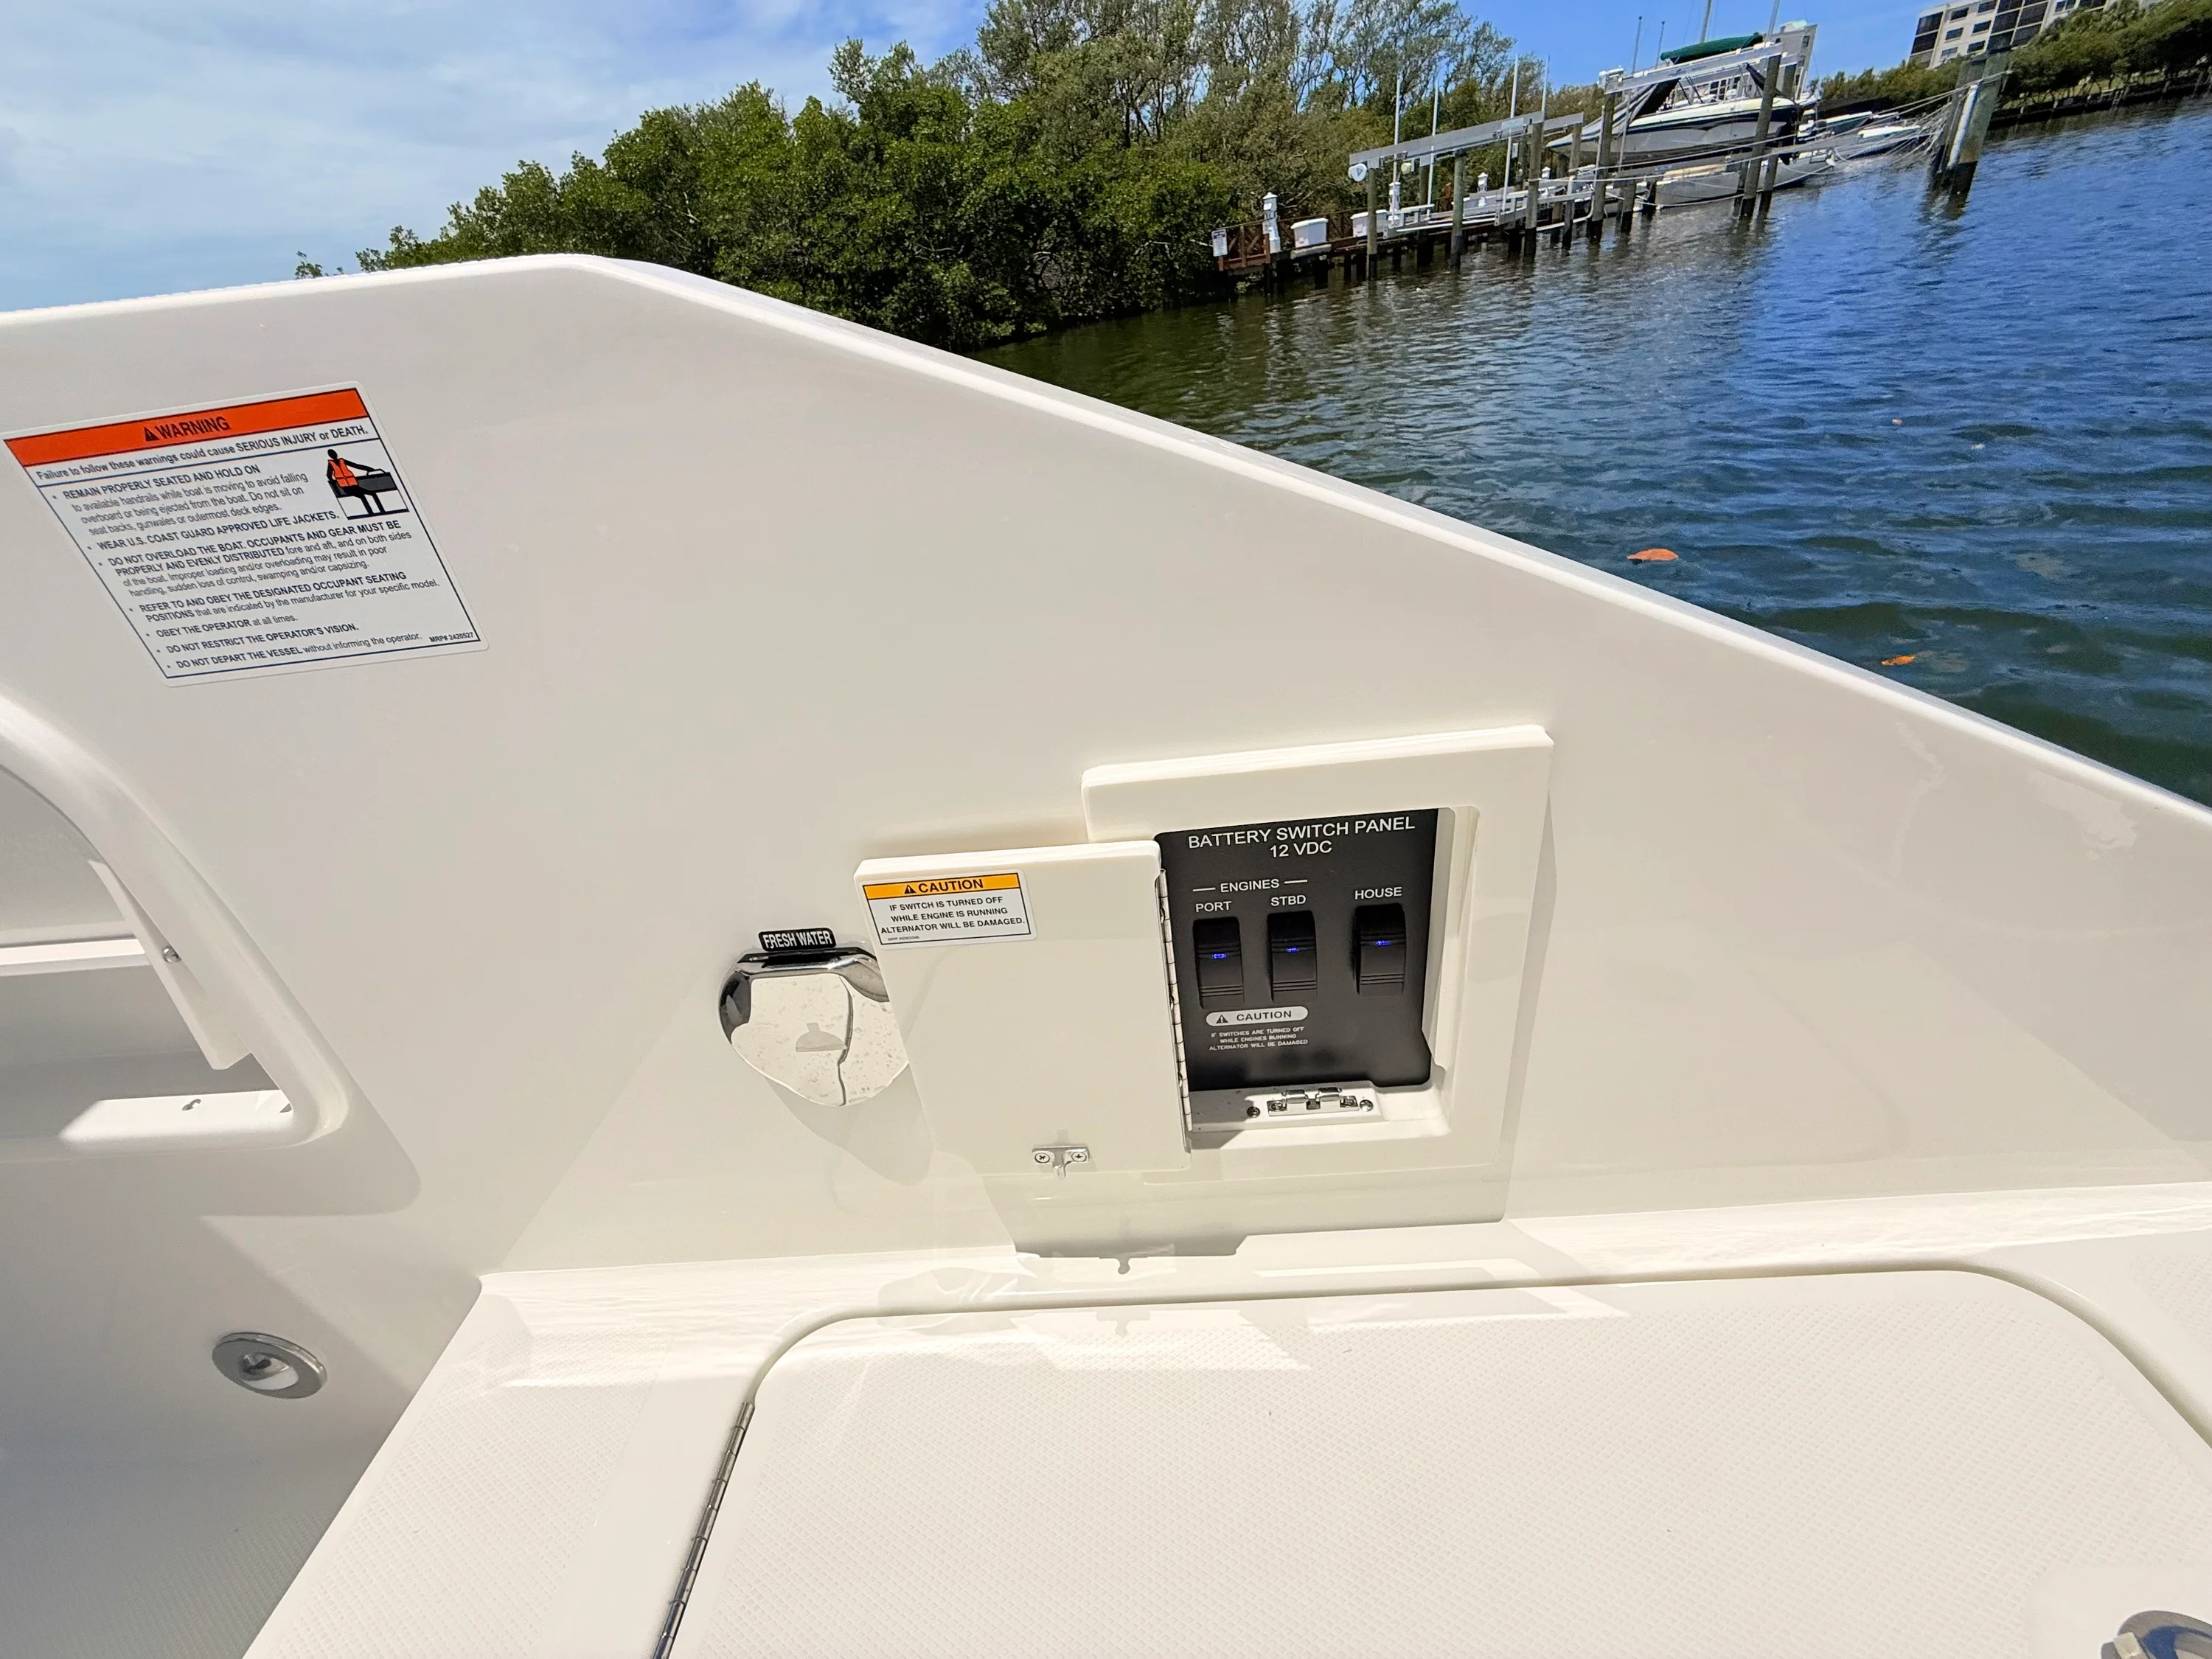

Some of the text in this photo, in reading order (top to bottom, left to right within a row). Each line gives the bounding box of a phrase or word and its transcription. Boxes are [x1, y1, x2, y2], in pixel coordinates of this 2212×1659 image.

[155, 416, 231, 439] WARNING
[35, 425, 369, 480] Failure to follow these warnings could cause SERIOUS INJURY or DEATH.
[62, 464, 261, 499] REMAIN PROPERLY SEATED AND HOLD ON
[71, 473, 309, 512] to available handrails while boat is moving to avoid falling
[88, 504, 282, 536] seat backs, gunwales or outermost deck edges.
[97, 510, 340, 550] WEAR U.S. COAST GUARD APPROVED LIFE JACKETS.
[107, 520, 402, 566] DO NOT OVERLOAD THE BOAT. OCCUPANTS AND GEAR MUST BE
[115, 532, 412, 577] PROPERLY AND EVENLY DISTRIBUTED fore and aft, and on both sides
[128, 560, 369, 597] handling, sudden loss of control, swamping and/or capsizing.
[139, 571, 407, 613] REFER TO AND OBEY THE DESIGNATED OCCUPANT SEATING
[145, 578, 440, 622] POSITIONS that are indicated by the manufacturer for your specific model.
[156, 615, 298, 638] OBEY THE OPERATOR at all times.
[166, 644, 181, 653] DO
[181, 642, 201, 652] NOT
[201, 636, 245, 649] RESTRICT
[245, 634, 266, 644] THE
[323, 623, 359, 634] VISION.
[175, 633, 422, 669] DO NOT DEPART THE VESSEL without informing the operator.
[1189, 816, 1415, 849] BATTERY SWITCH PANEL
[1270, 840, 1332, 858] 12 VDC
[918, 879, 985, 893] CAUTION
[1220, 878, 1280, 893] ENGINES
[1354, 886, 1402, 900] HOUSE
[899, 902, 934, 911] SWITCH
[936, 900, 945, 908] IS
[946, 897, 984, 907] TURNED
[985, 896, 1003, 904] OFF
[1195, 900, 1232, 913] PORT
[1270, 894, 1307, 906] STBD
[881, 917, 1025, 934] ALTERNATOR WILL BE DAMAGED.
[890, 914, 919, 922] WHILE
[920, 911, 955, 920] ENGINE
[967, 907, 1008, 917] RUNNING
[762, 931, 833, 949] FRESH WATER
[1236, 1010, 1292, 1021] CAUTION
